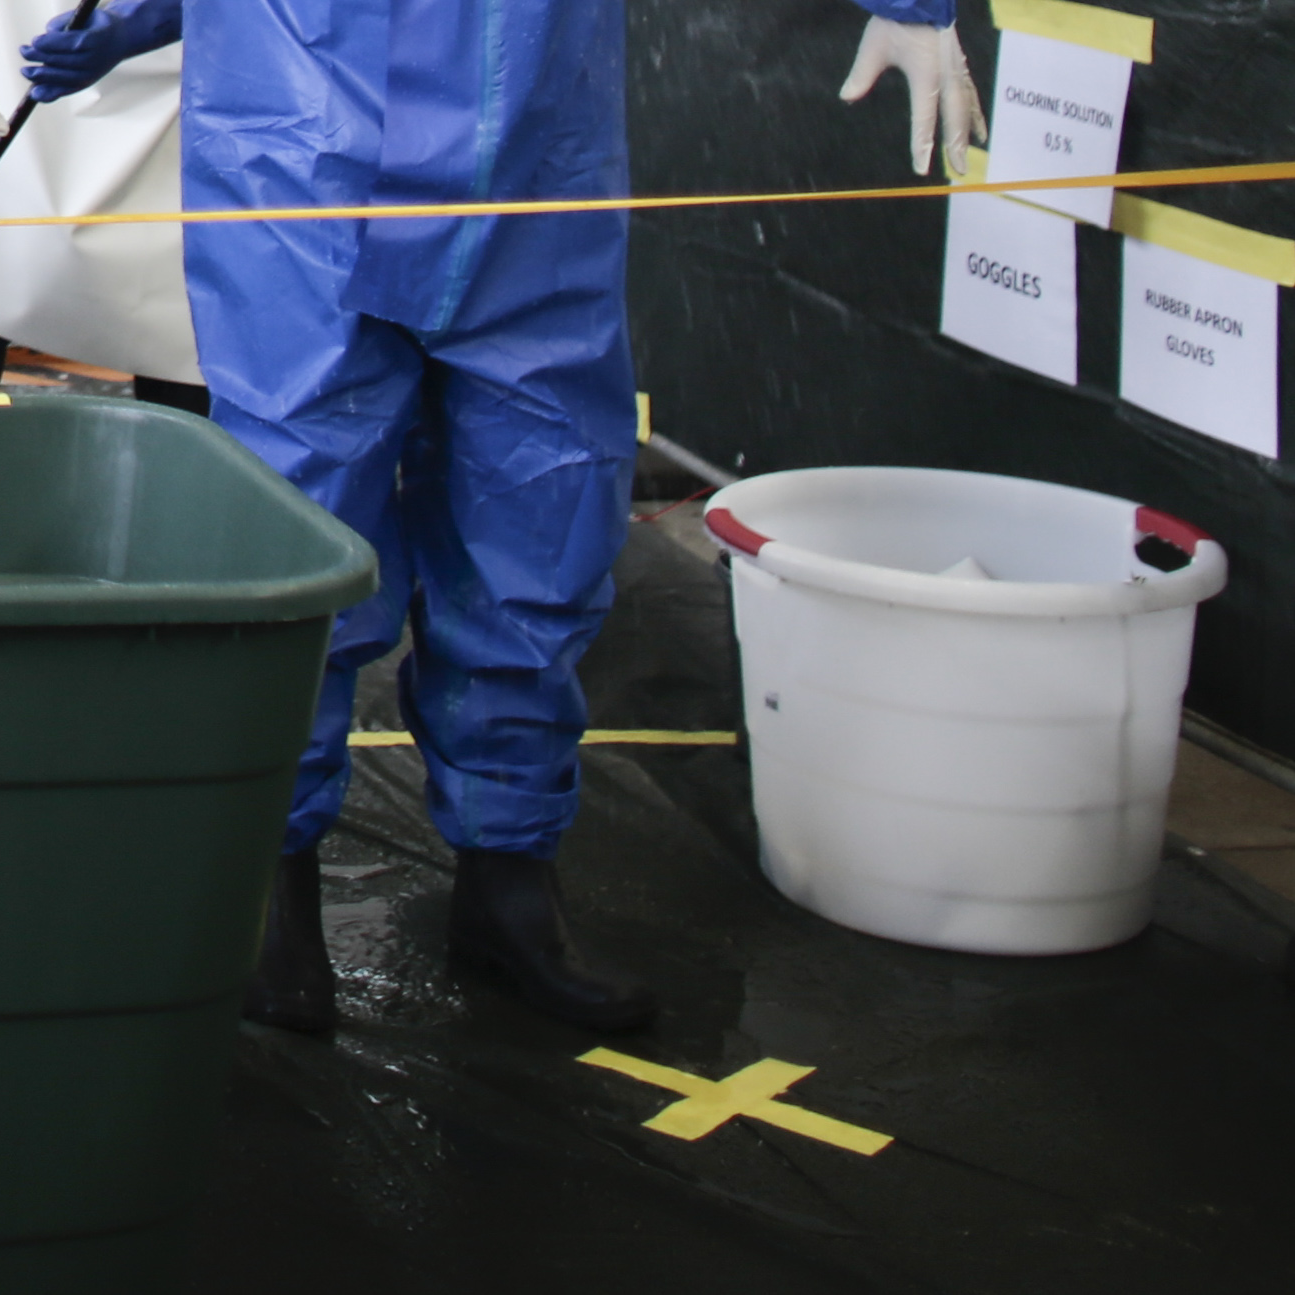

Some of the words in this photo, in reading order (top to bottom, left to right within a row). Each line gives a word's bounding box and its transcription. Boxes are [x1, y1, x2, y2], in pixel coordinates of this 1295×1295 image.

[1005, 85, 1060, 114] CHLORINE
[1062, 100, 1113, 130] SOLUTION
[1045, 132, 1061, 153] 0,5
[967, 252, 1042, 300] GOGGLES
[1145, 288, 1191, 321] RUBBER
[1194, 305, 1243, 339] APRON
[1166, 335, 1215, 367] GLOVES
